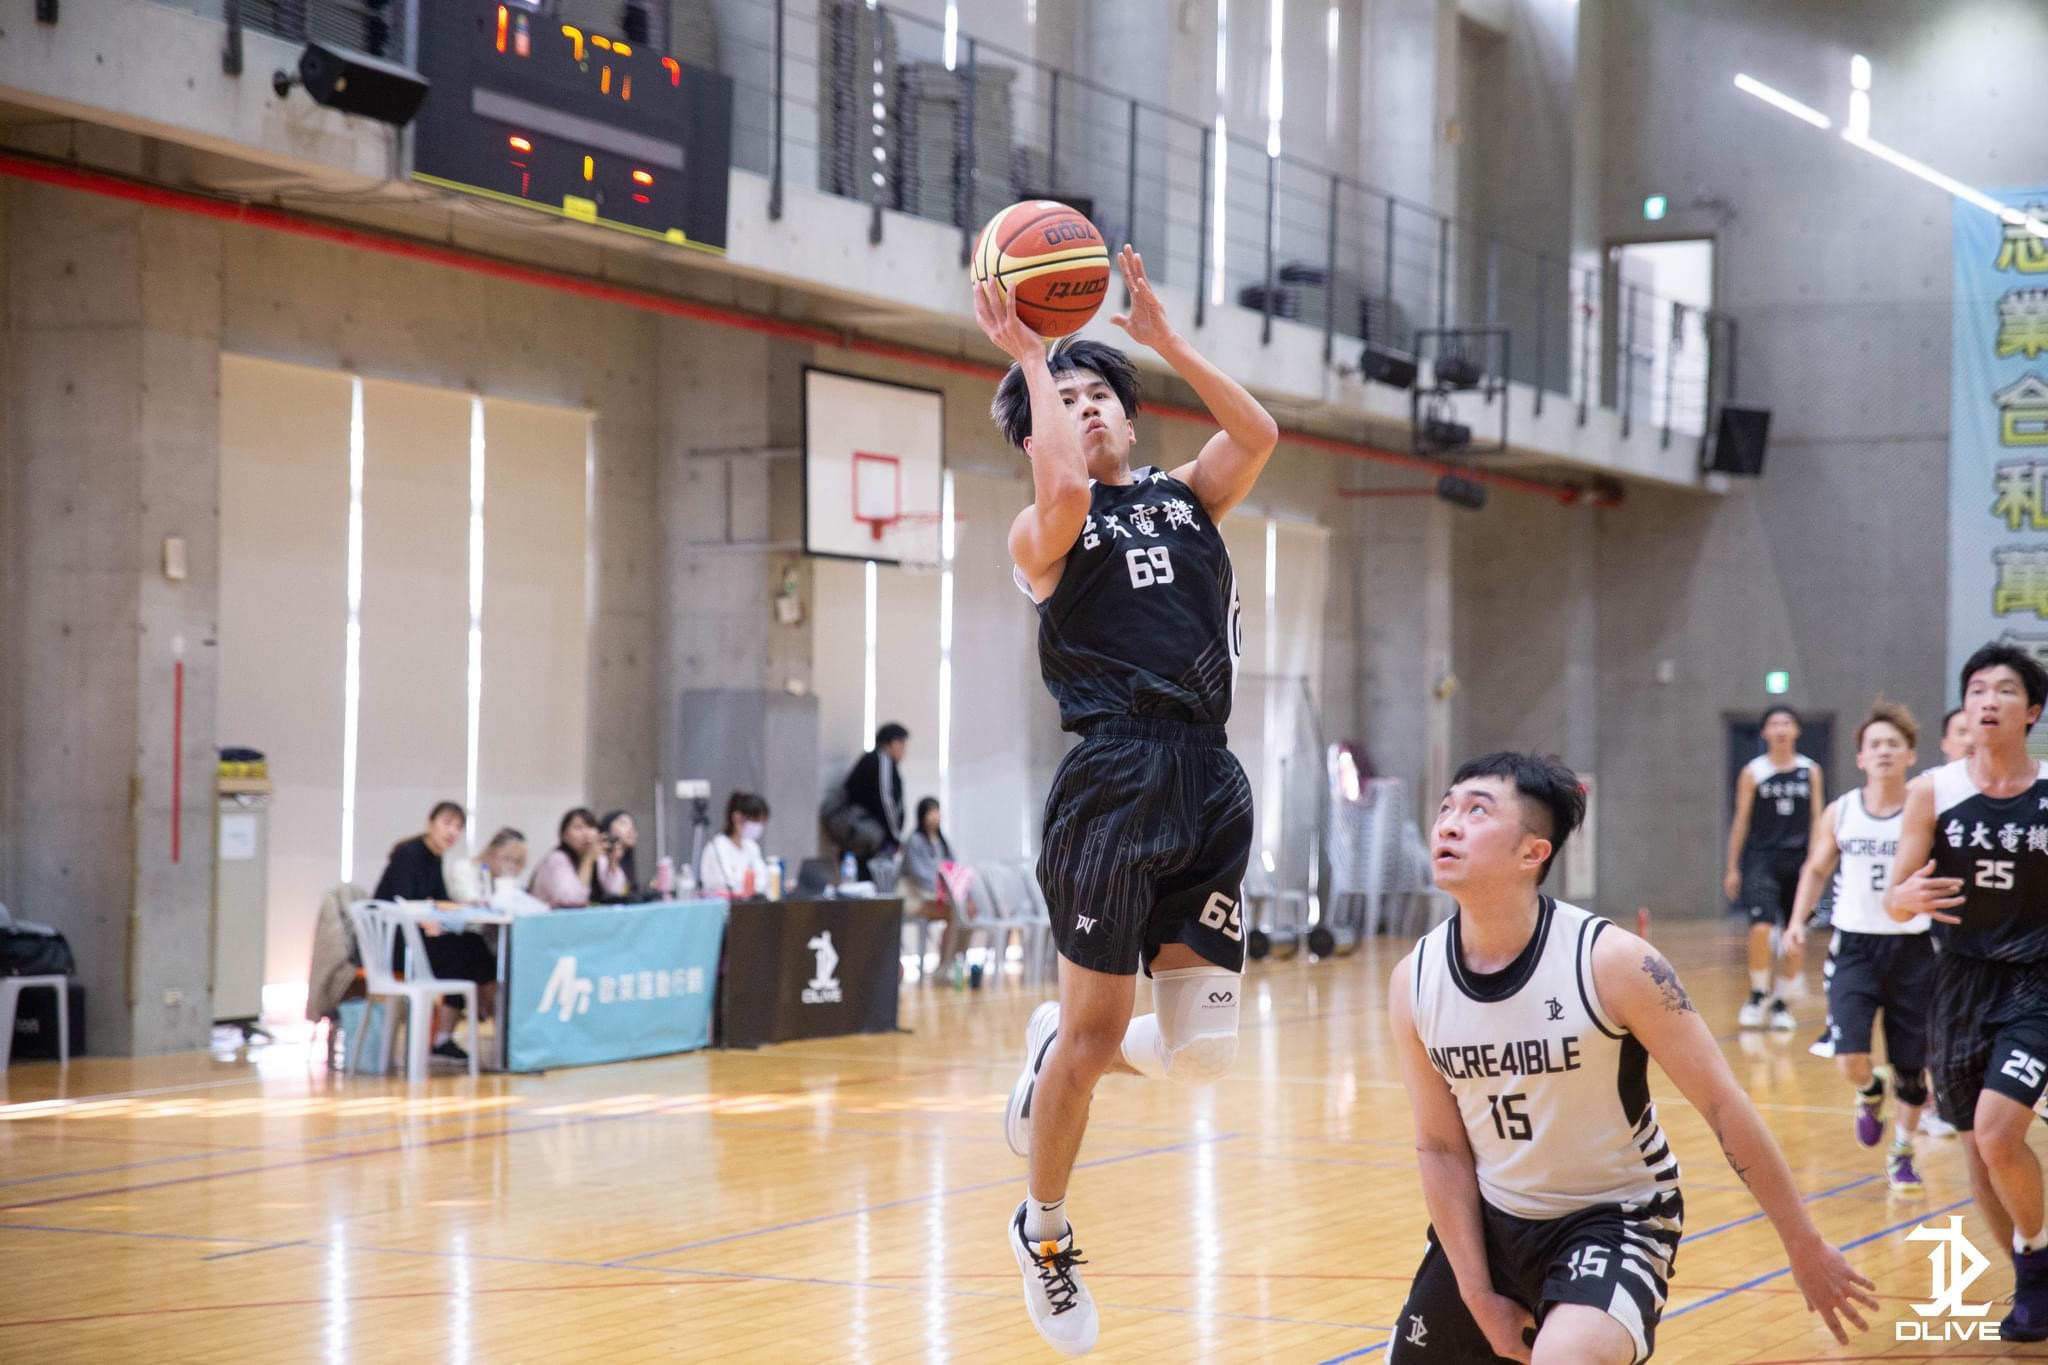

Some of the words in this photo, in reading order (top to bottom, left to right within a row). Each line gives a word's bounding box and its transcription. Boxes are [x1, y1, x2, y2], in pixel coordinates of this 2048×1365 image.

[1082, 498, 1201, 550] 台大電機
[1125, 546, 1175, 589] 69
[1975, 860, 2015, 890] 25
[2000, 1049, 2046, 1088] 25
[1488, 1093, 1533, 1141] 15
[1568, 1245, 1611, 1281] 15
